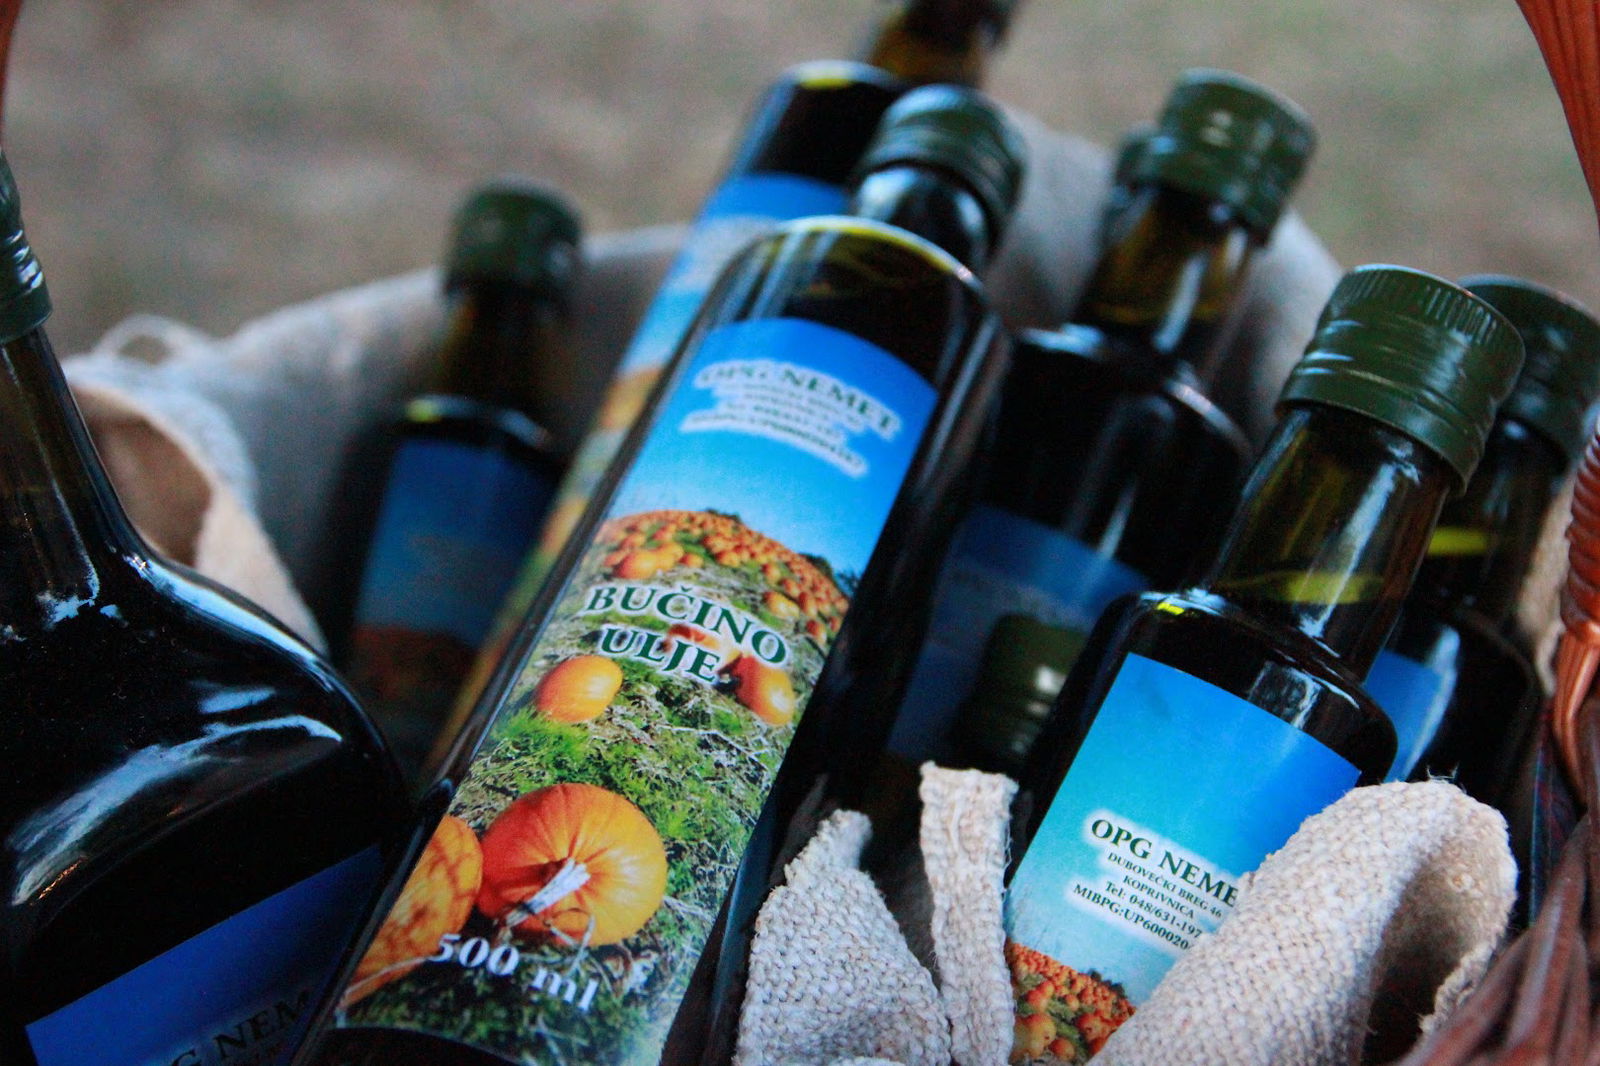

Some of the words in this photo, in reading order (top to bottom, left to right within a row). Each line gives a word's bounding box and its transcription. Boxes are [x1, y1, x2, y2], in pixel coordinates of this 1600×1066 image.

[585, 585, 788, 664] BUČINO
[600, 628, 721, 682] ULJE
[1091, 819, 1153, 860] OPG
[1104, 880, 1126, 899] Tel:
[1129, 893, 1203, 939] 048/631-197
[1107, 852, 1177, 893] DUBOVEČKI
[1178, 886, 1209, 911] BREG
[1209, 905, 1223, 919] 46
[1122, 875, 1195, 919] KOPRIVNICA
[1072, 884, 1194, 951] MIBPG:UP600020
[427, 933, 520, 977] 500
[530, 966, 600, 1012] ml
